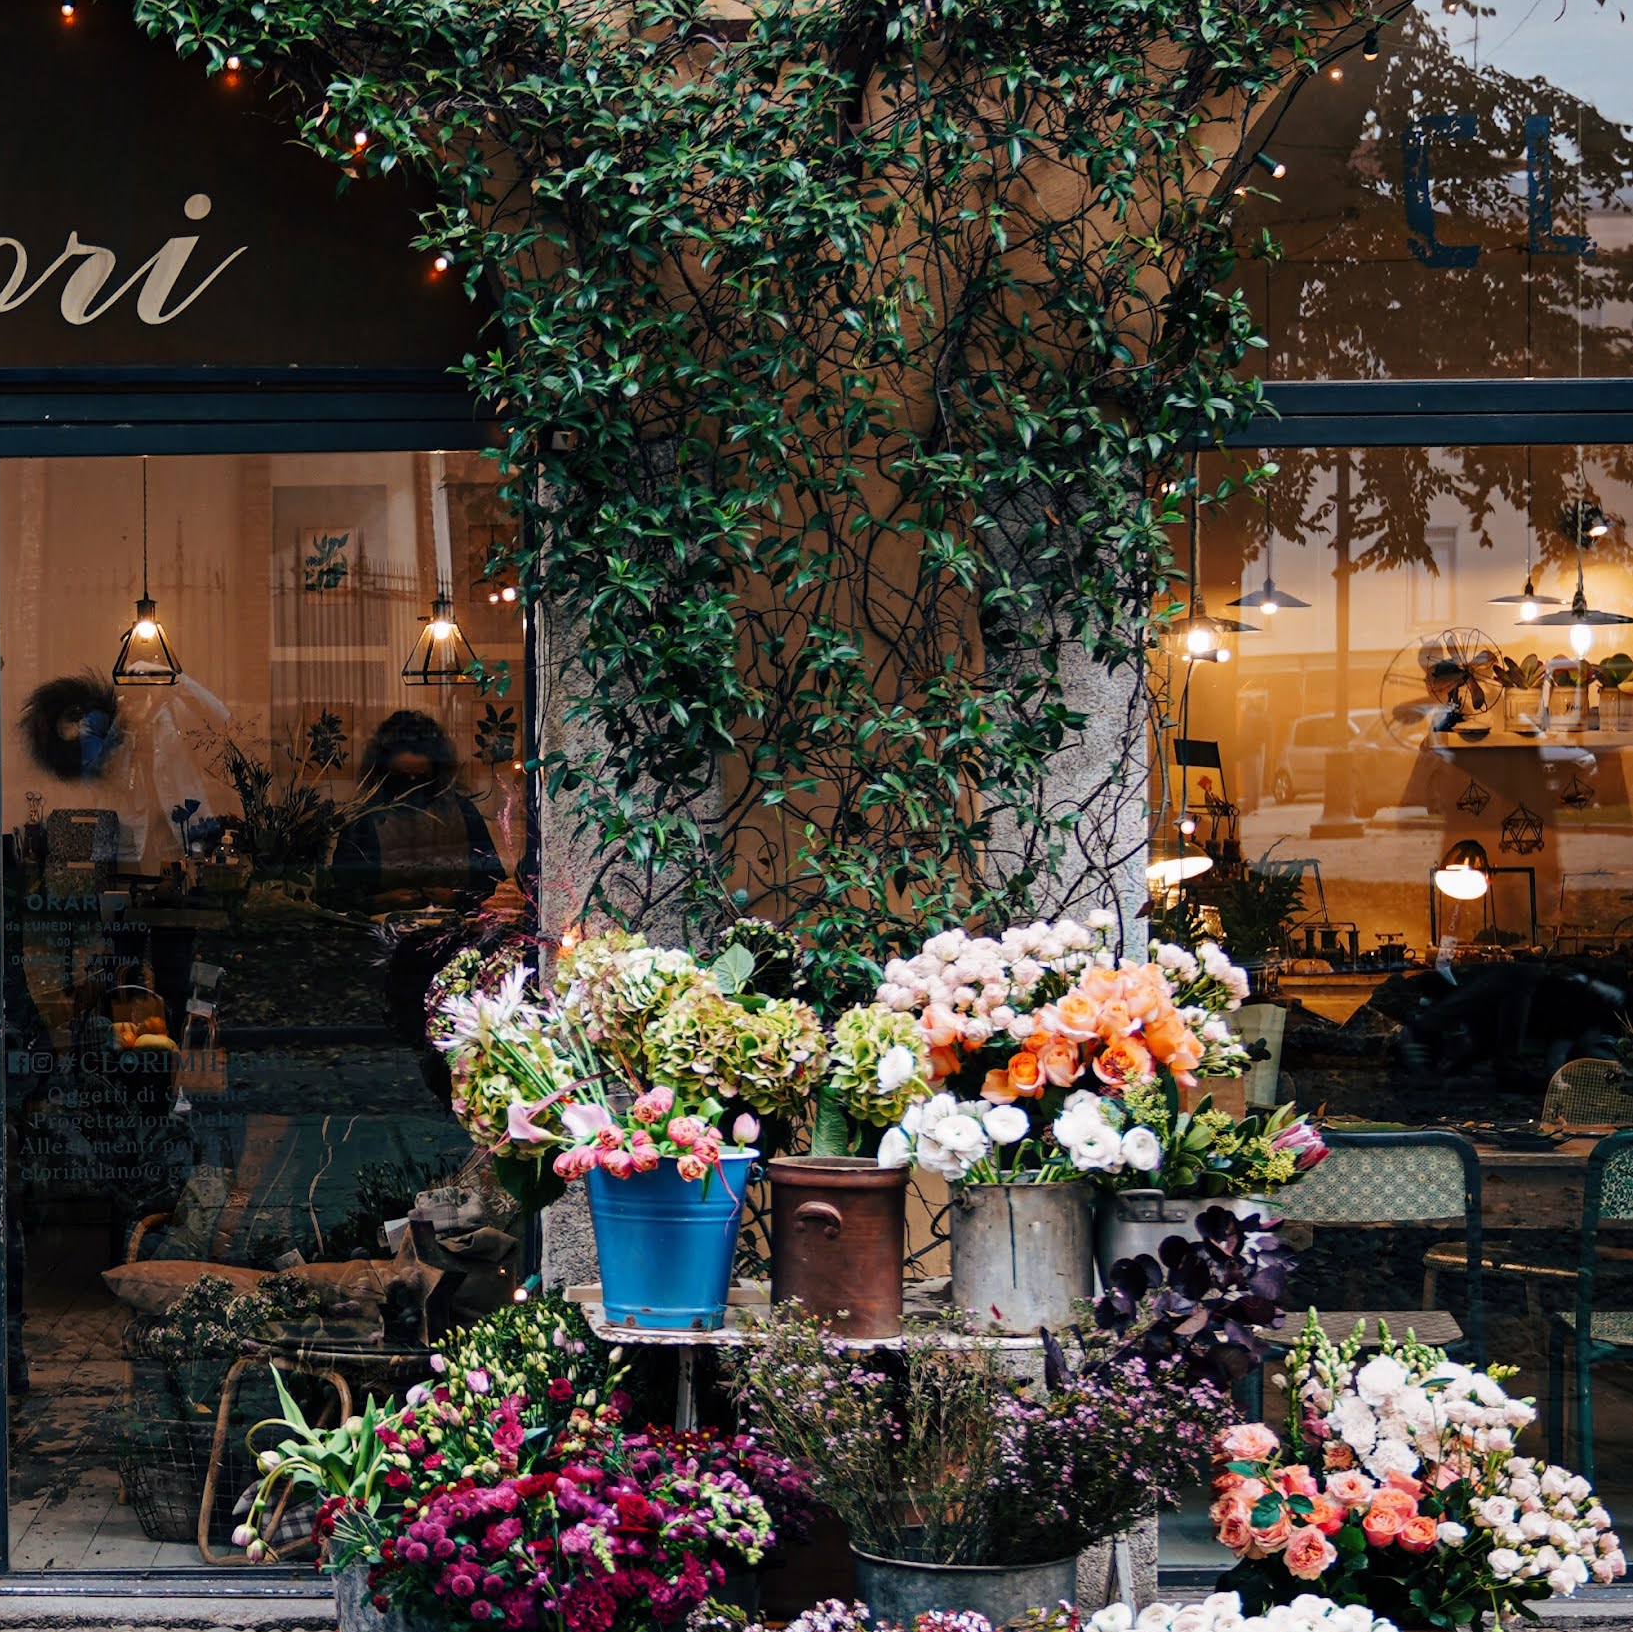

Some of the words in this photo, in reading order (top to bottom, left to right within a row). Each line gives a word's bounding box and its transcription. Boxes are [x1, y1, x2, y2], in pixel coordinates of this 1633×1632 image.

[25, 893, 127, 912] ORARO
[56, 1050, 289, 1074] #CLORIMILAO
[48, 1085, 128, 1109] Oggetti
[137, 1084, 156, 1104] di
[32, 1111, 179, 1133] Progettazion
[19, 1136, 154, 1155] Allesmenti
